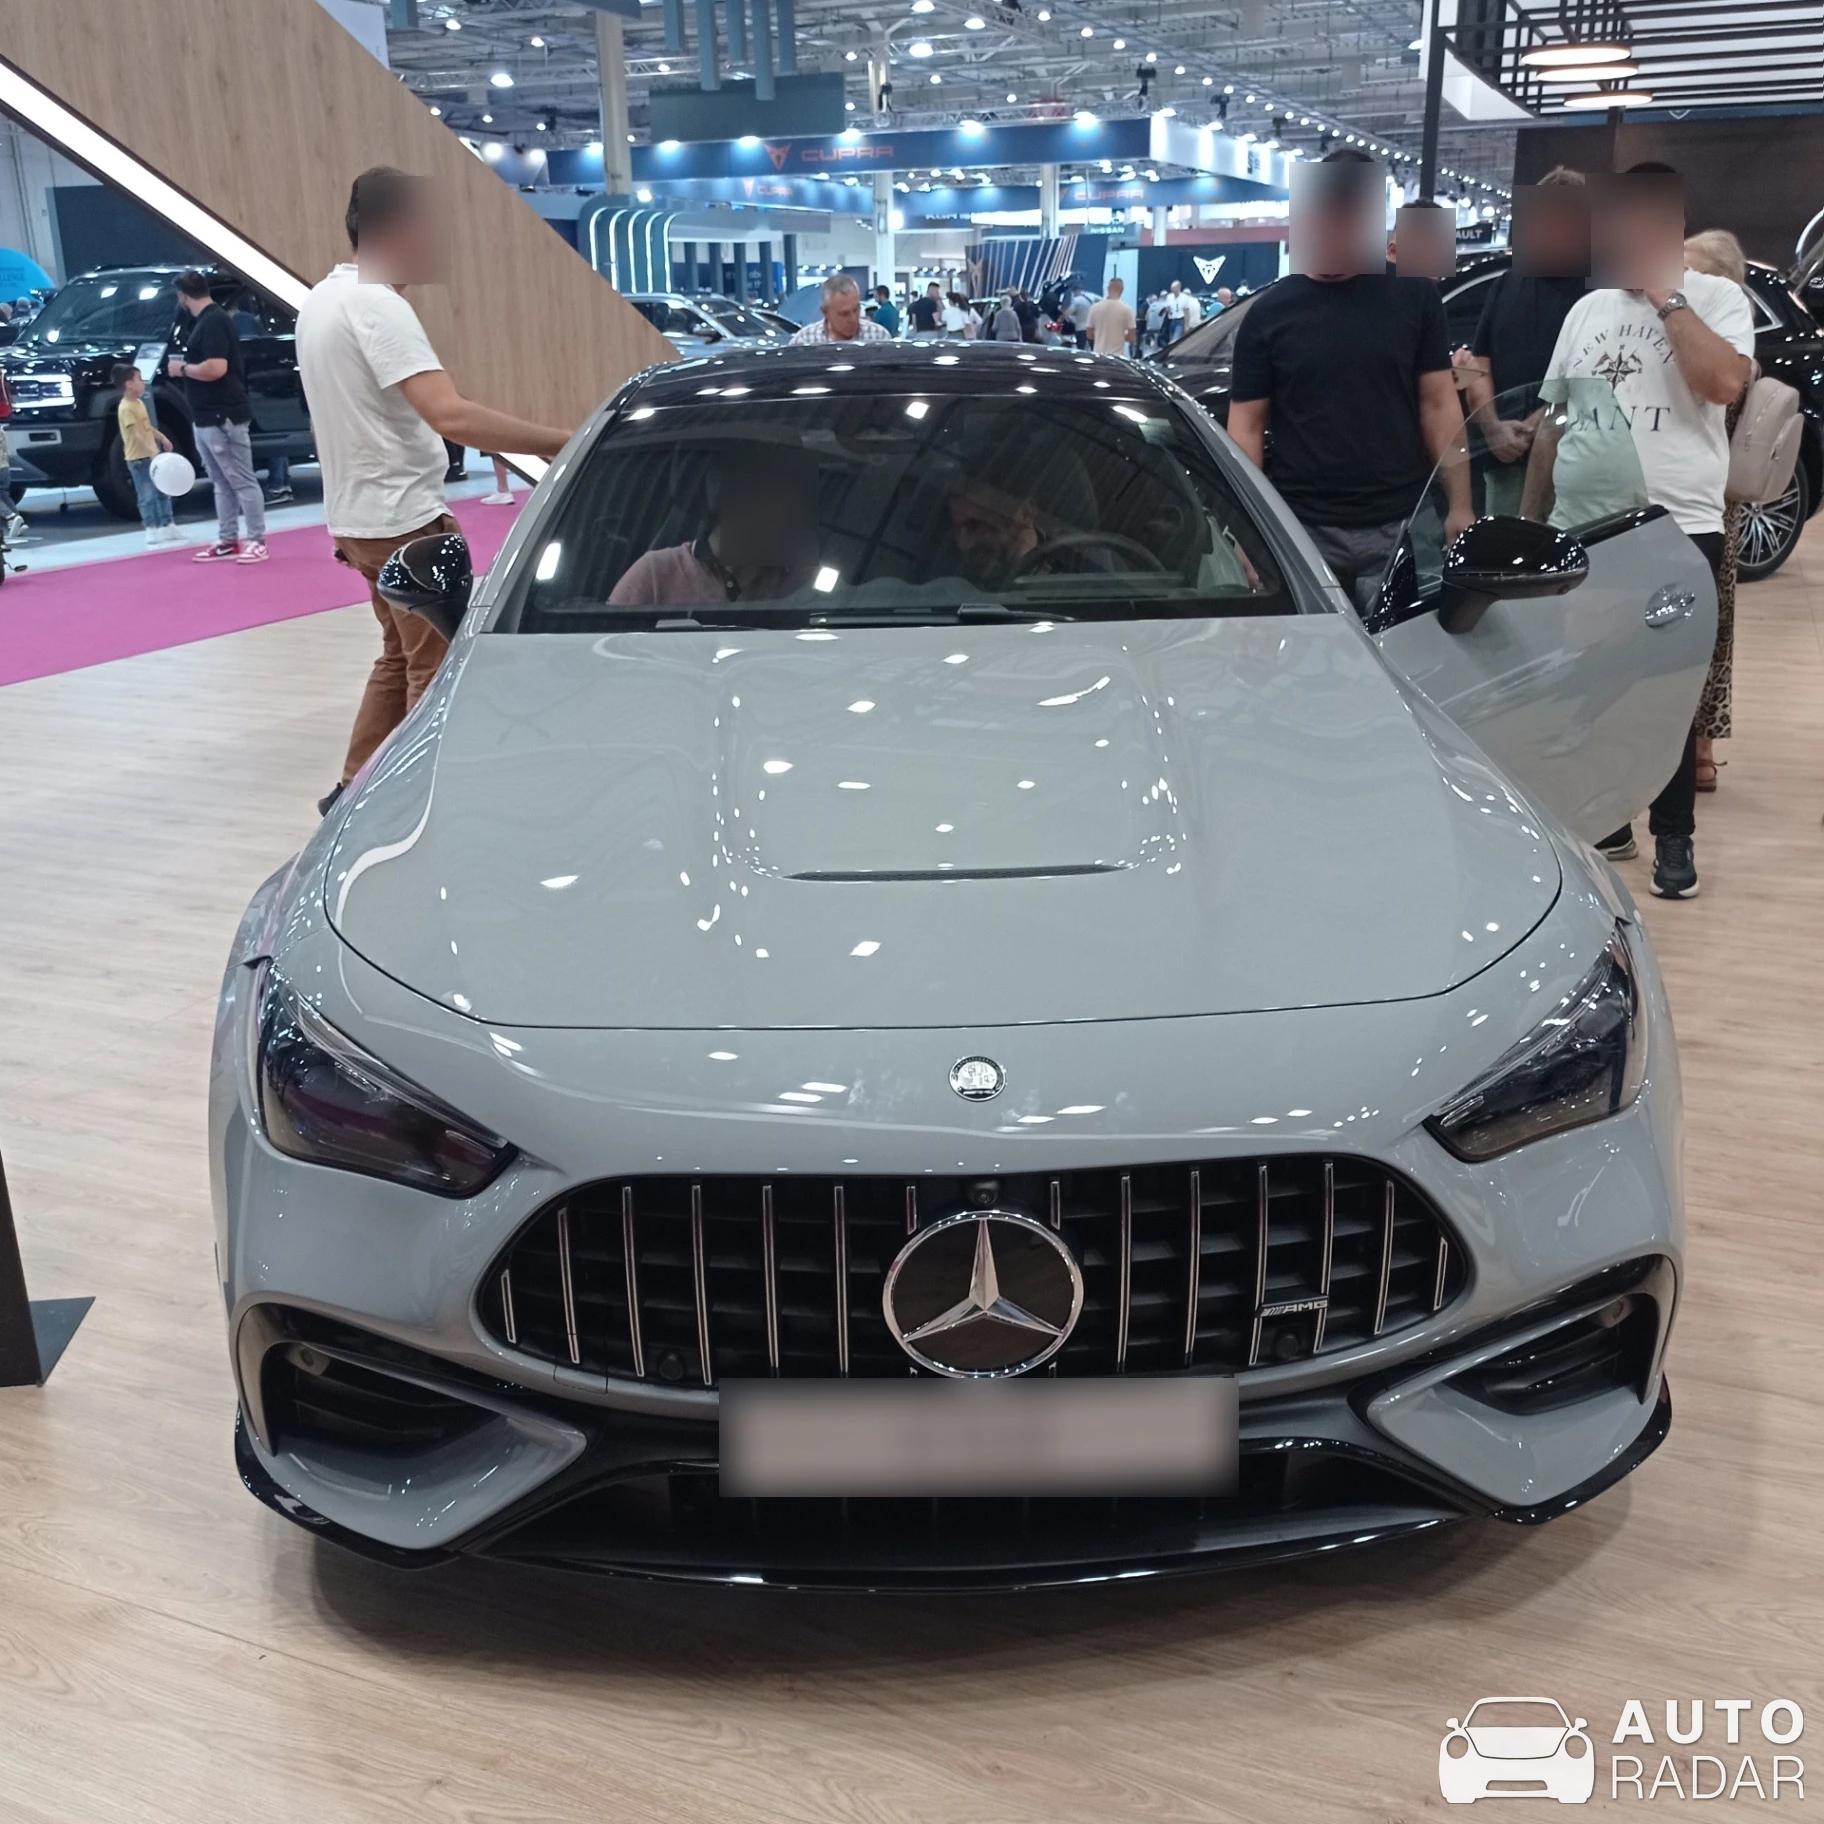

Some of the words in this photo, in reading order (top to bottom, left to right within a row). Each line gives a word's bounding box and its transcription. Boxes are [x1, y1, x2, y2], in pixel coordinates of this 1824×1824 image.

[802, 146, 893, 161] CUPRA
[1074, 189, 1144, 200] CUPRA
[1090, 226, 1125, 234] NISSAN
[1455, 228, 1483, 239] AULT
[1618, 324, 1676, 365] HAVEN
[1281, 1300, 1328, 1315] AMG
